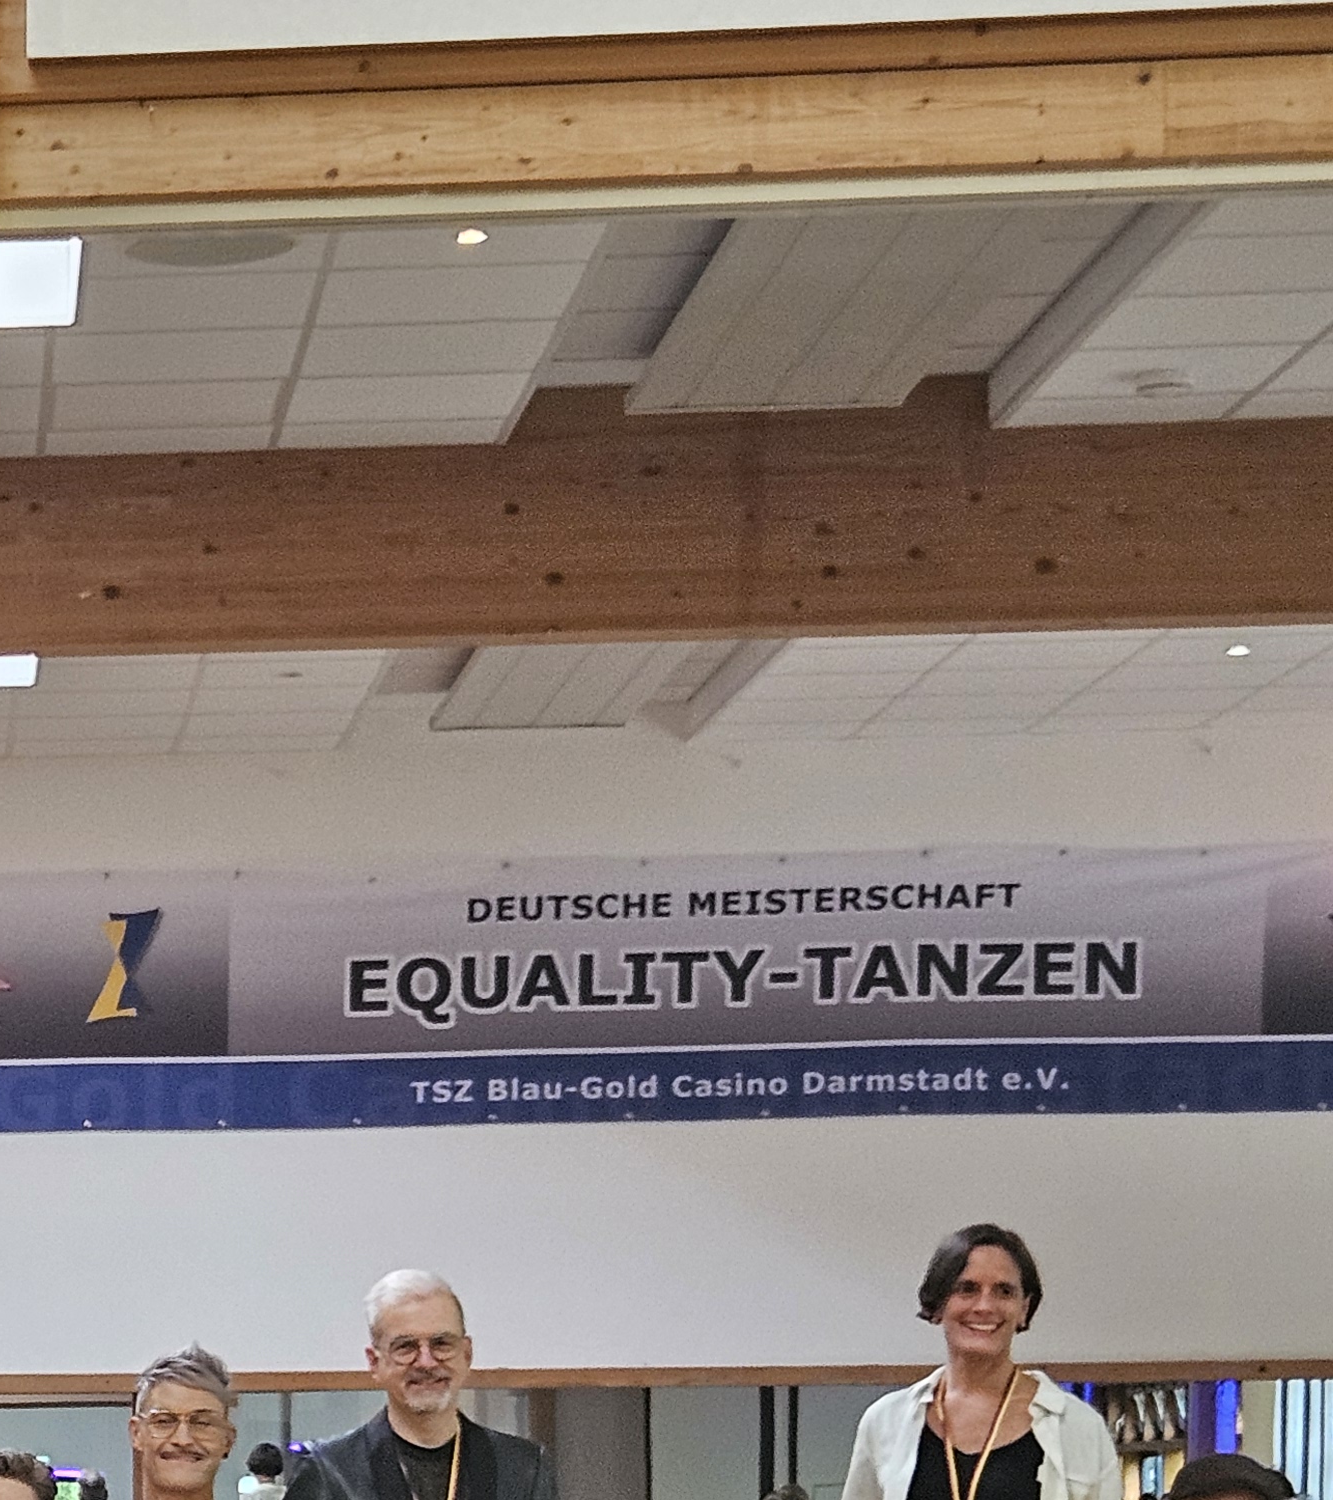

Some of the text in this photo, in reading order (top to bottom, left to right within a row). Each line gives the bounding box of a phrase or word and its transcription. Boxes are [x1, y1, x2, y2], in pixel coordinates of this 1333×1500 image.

[466, 882, 1022, 923] DEUTSCHE MEISTERSCHAFT
[346, 939, 1139, 1027] EQUALITY-TANZEN
[409, 1078, 475, 1104] TSZ
[487, 1075, 658, 1102] Blau-Gold
[671, 1072, 788, 1099] Casino
[802, 1067, 989, 1095] Darmstadt
[1001, 1067, 1070, 1091] e.V.
